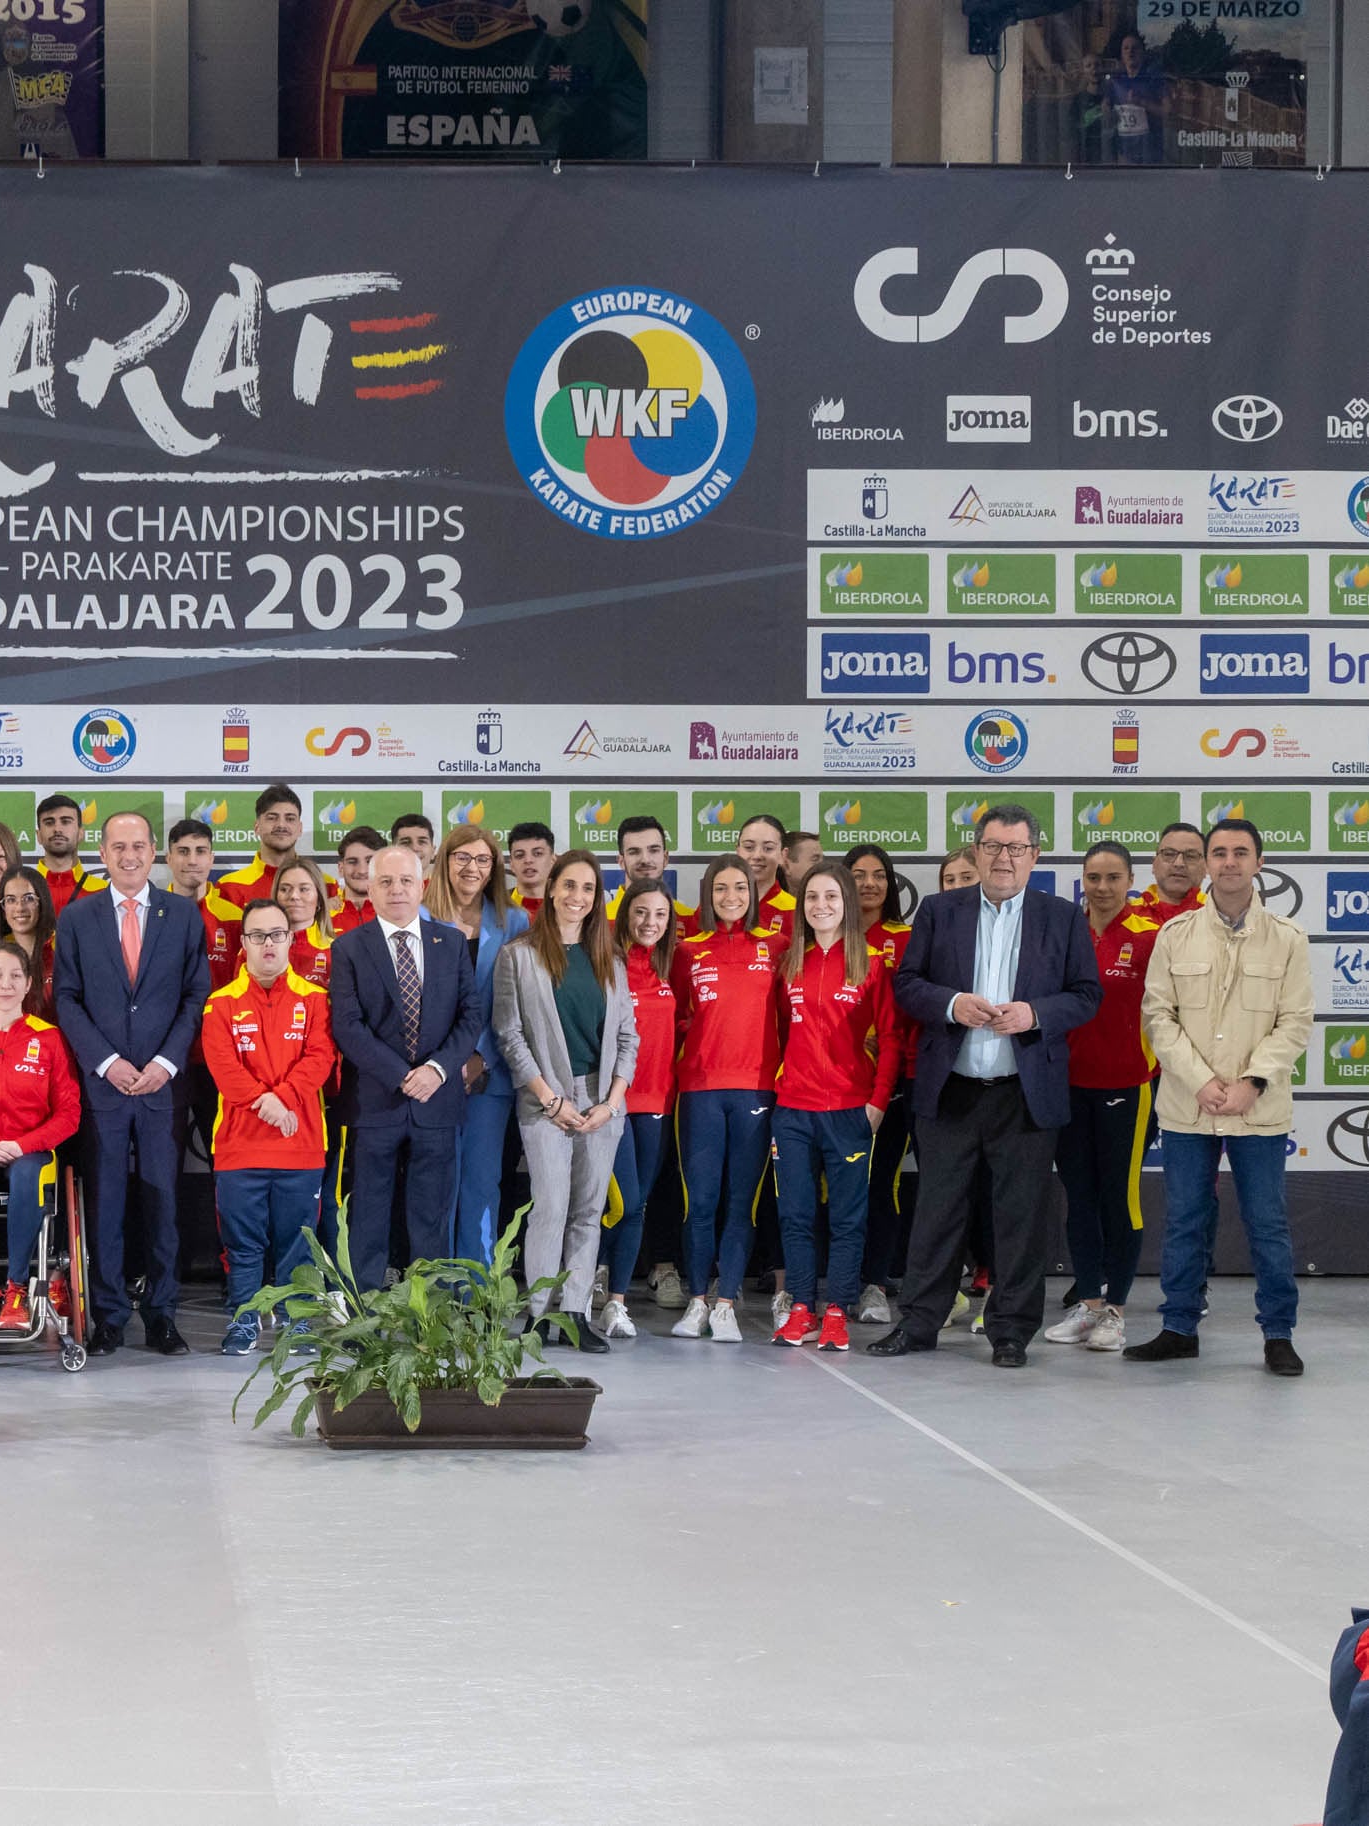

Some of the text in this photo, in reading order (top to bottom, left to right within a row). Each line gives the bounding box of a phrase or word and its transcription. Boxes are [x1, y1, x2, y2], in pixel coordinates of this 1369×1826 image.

[1148, 0, 1300, 17] 29 DE MARZO
[388, 65, 538, 80] PARTIDO INTERNACIONAL
[397, 81, 413, 94] DE
[467, 81, 529, 94] FEMENINO
[387, 108, 541, 146] ESPAÑA
[1247, 132, 1297, 147] Mancha
[1092, 284, 1171, 303] Consejo
[571, 292, 693, 325] EUROPEAN
[1093, 306, 1177, 326] Superior
[1092, 326, 1211, 347] de Deportes
[568, 386, 689, 438] WKF
[1074, 400, 1167, 437] bms.
[818, 428, 904, 440] IBERDROLA
[529, 468, 732, 535] KARATE FEDERATION
[1107, 496, 1183, 508] Ayuntamiento de
[988, 508, 1056, 517] GUADALAJARA
[1108, 509, 1183, 524] Guadalajara
[107, 506, 464, 542] CHAMPIONSHIPS
[885, 525, 926, 536] Mancha
[1265, 521, 1299, 534] 2023
[22, 552, 232, 580] PARAKARATE
[245, 554, 464, 630] 2023
[836, 592, 923, 604] IBERDROLA
[962, 593, 1050, 605] IBERDROLA
[1090, 593, 1175, 605] IBERDROLA
[1215, 593, 1303, 605] IBERDROLA
[948, 641, 1055, 683] bms.
[89, 734, 119, 748] WKF
[722, 731, 798, 742] Ayuntamiento de
[981, 734, 1012, 748] WKF
[603, 744, 671, 752] GUADALAJARA
[722, 745, 798, 760] Guadalajara
[499, 760, 540, 772] Mancha
[882, 755, 915, 767] 2023
[834, 831, 921, 842] IBERDROLA
